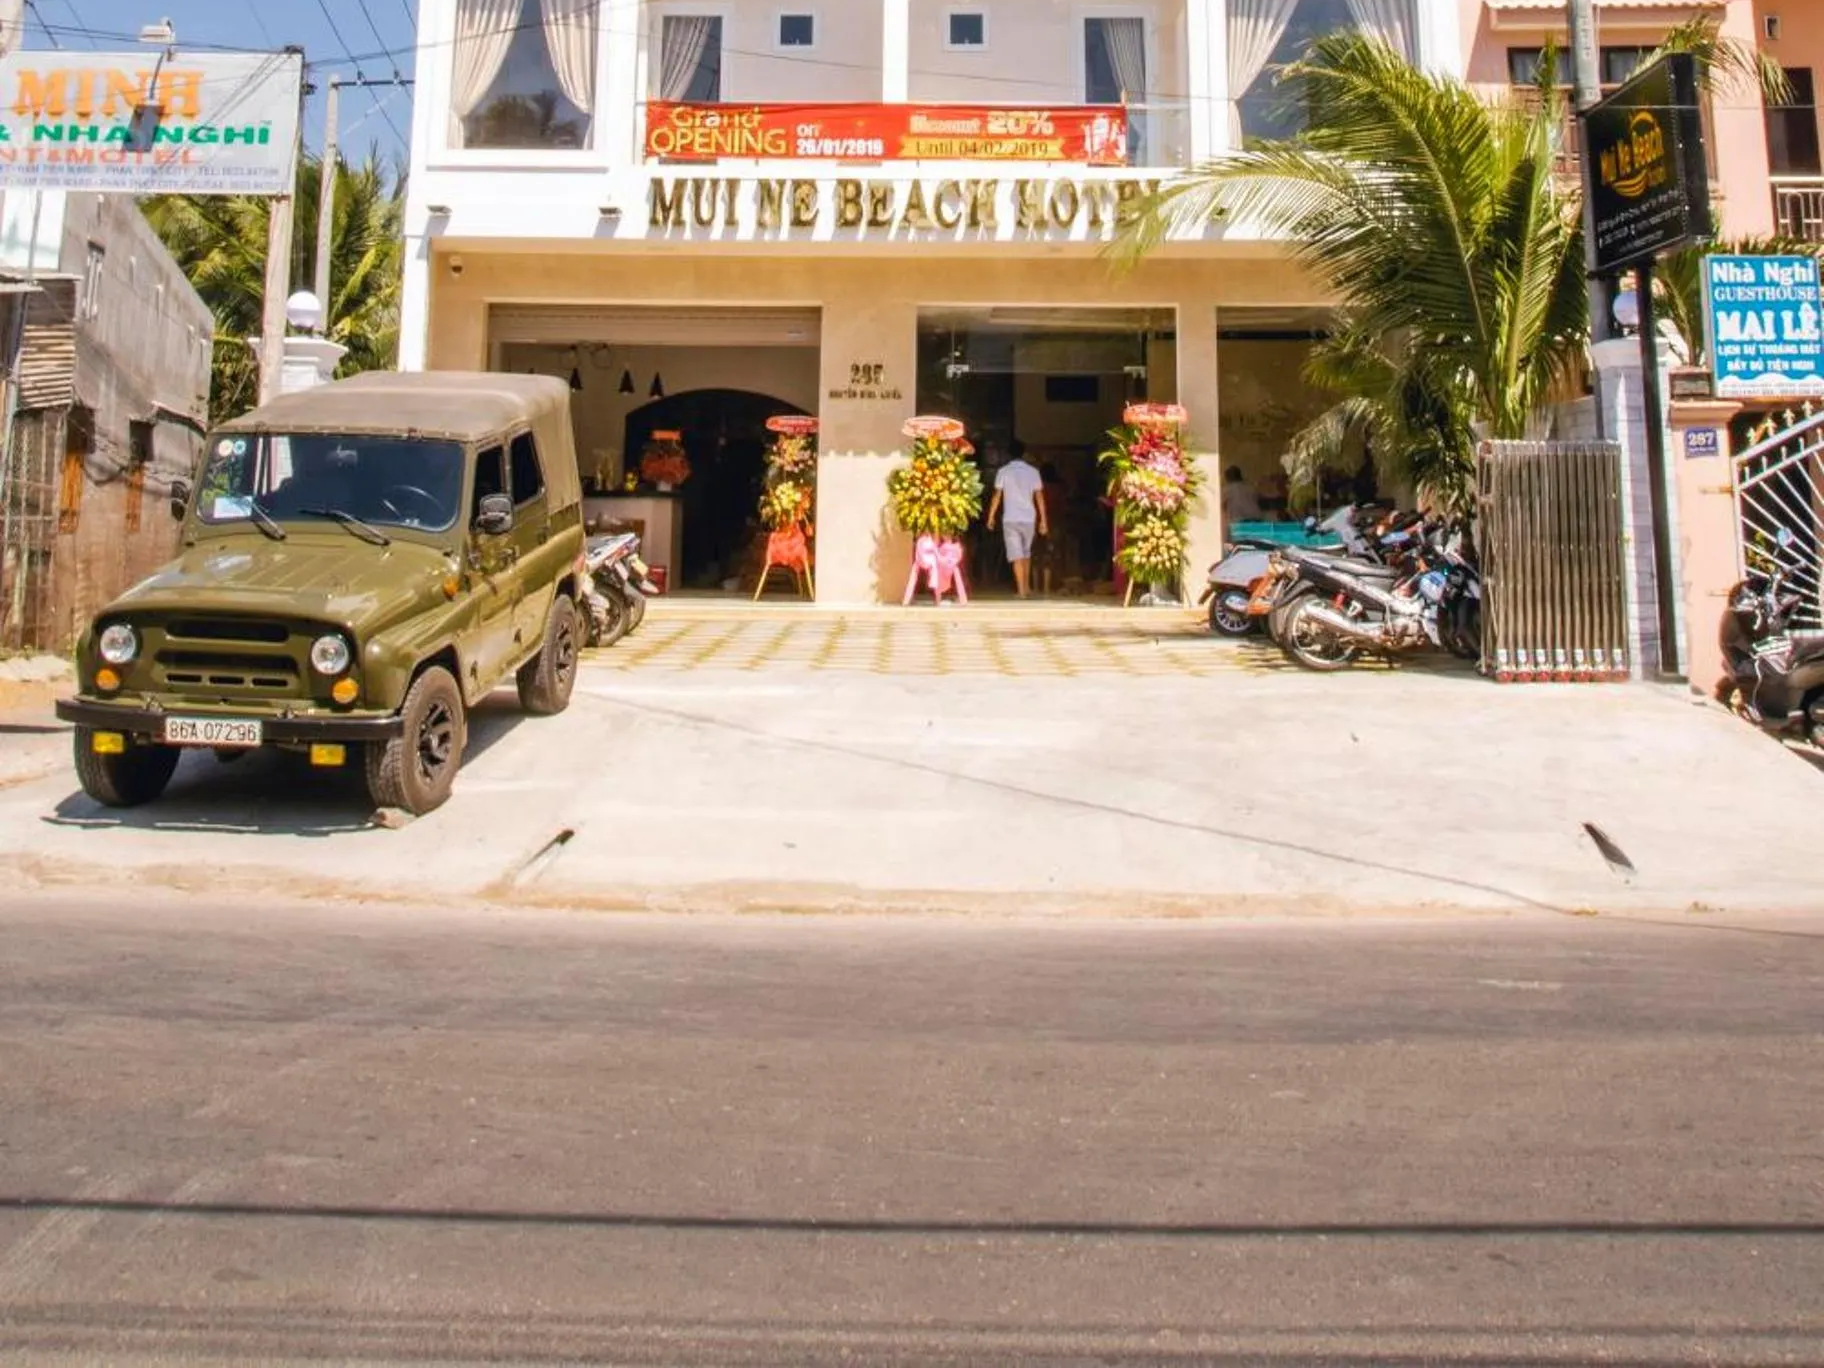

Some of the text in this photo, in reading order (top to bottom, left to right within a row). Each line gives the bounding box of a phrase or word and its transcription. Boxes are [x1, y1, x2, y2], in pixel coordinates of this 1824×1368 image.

[12, 69, 204, 117] MINH
[670, 106, 763, 128] Grand
[650, 126, 787, 155] OPENING
[915, 140, 953, 156] Until
[649, 178, 1160, 229] MUI NE BEACH HOTE
[1712, 261, 1756, 283] Nhà
[1714, 286, 1818, 302] GUESTHOUSE
[1716, 310, 1777, 341] MAI
